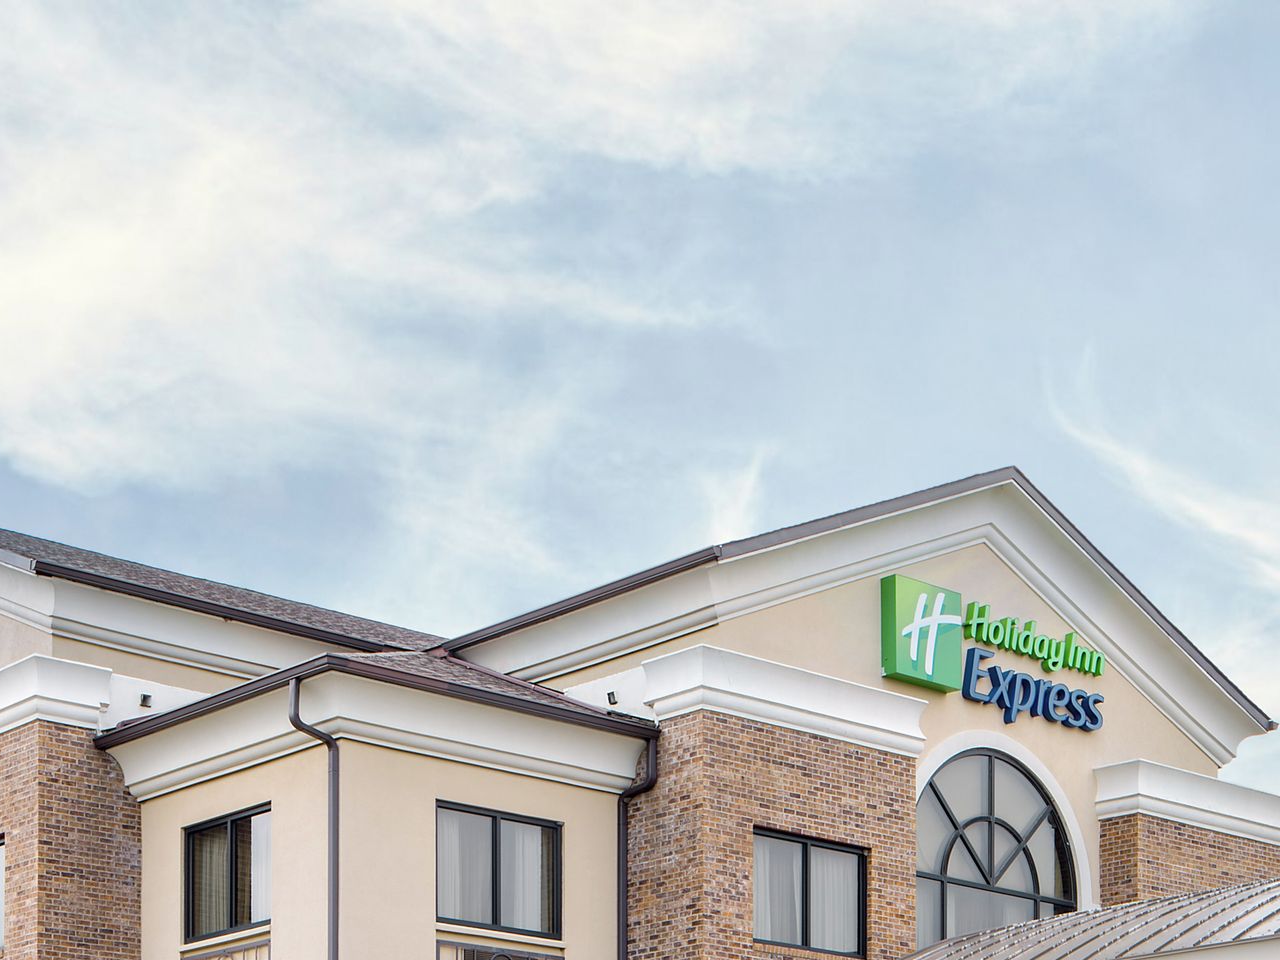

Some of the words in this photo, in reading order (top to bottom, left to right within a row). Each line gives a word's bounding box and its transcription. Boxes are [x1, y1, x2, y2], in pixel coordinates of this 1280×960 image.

[963, 601, 1065, 673] Holiday
[1063, 632, 1105, 677] Inn
[961, 647, 1105, 732] Express
